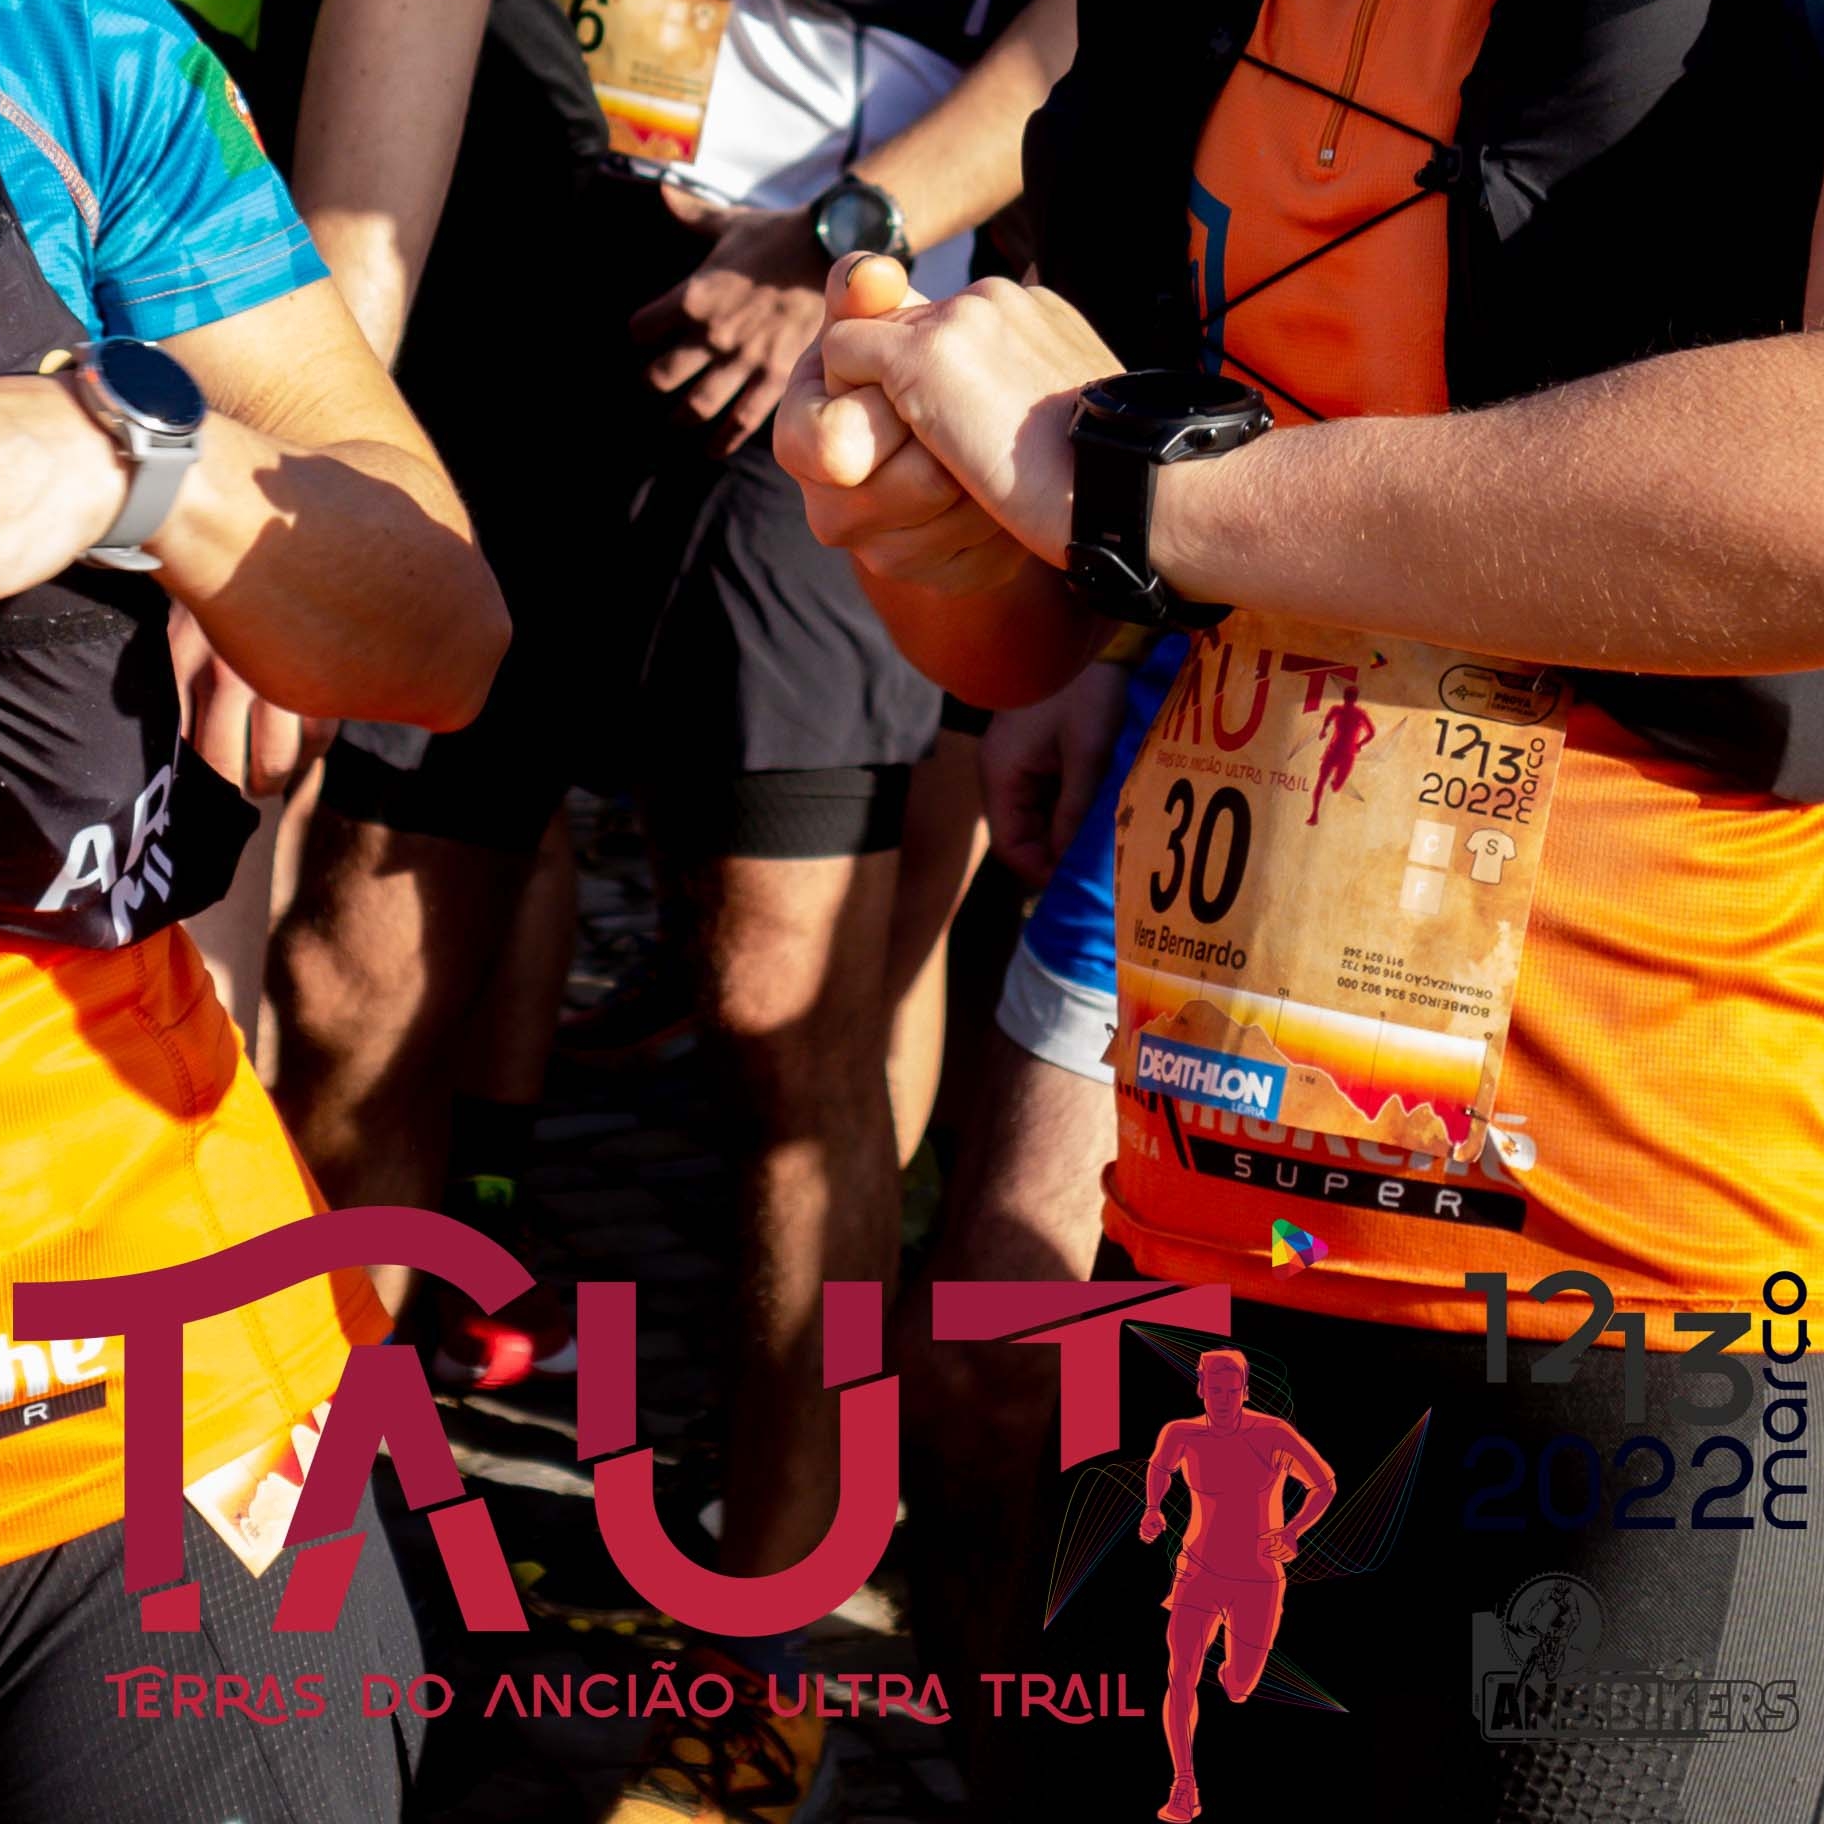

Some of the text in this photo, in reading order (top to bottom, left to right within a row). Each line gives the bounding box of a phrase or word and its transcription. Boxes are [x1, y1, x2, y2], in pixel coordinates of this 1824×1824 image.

[1418, 772, 1517, 822] 2022
[1148, 778, 1252, 925] 30
[1484, 838, 1499, 856] S
[1158, 925, 1248, 971] Bernardo
[1408, 992, 1491, 1018] BOMBEIROS
[1138, 1045, 1274, 1109] DECATHLON
